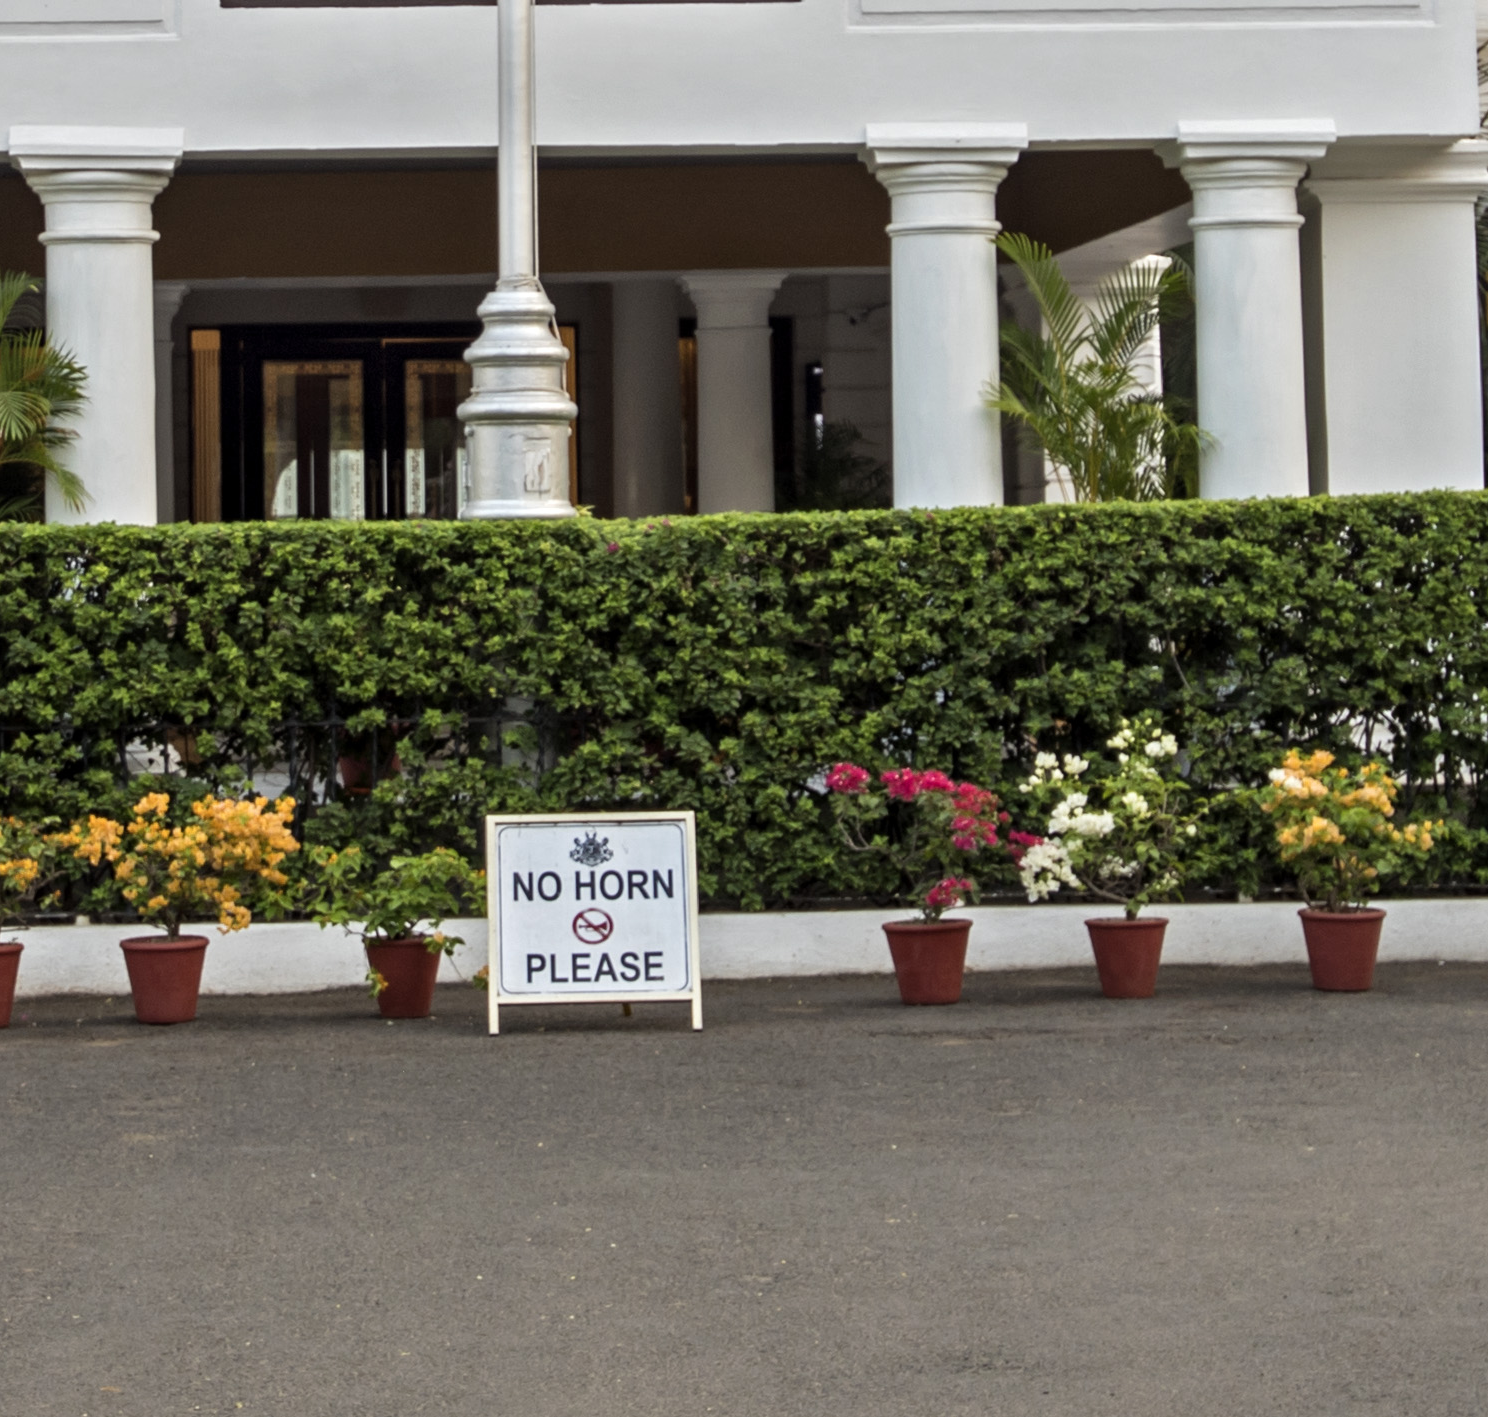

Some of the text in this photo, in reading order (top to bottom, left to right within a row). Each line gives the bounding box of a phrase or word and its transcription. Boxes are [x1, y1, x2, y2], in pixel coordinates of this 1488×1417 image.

[513, 869, 674, 901] NO HORN
[526, 951, 665, 984] PLEASE
